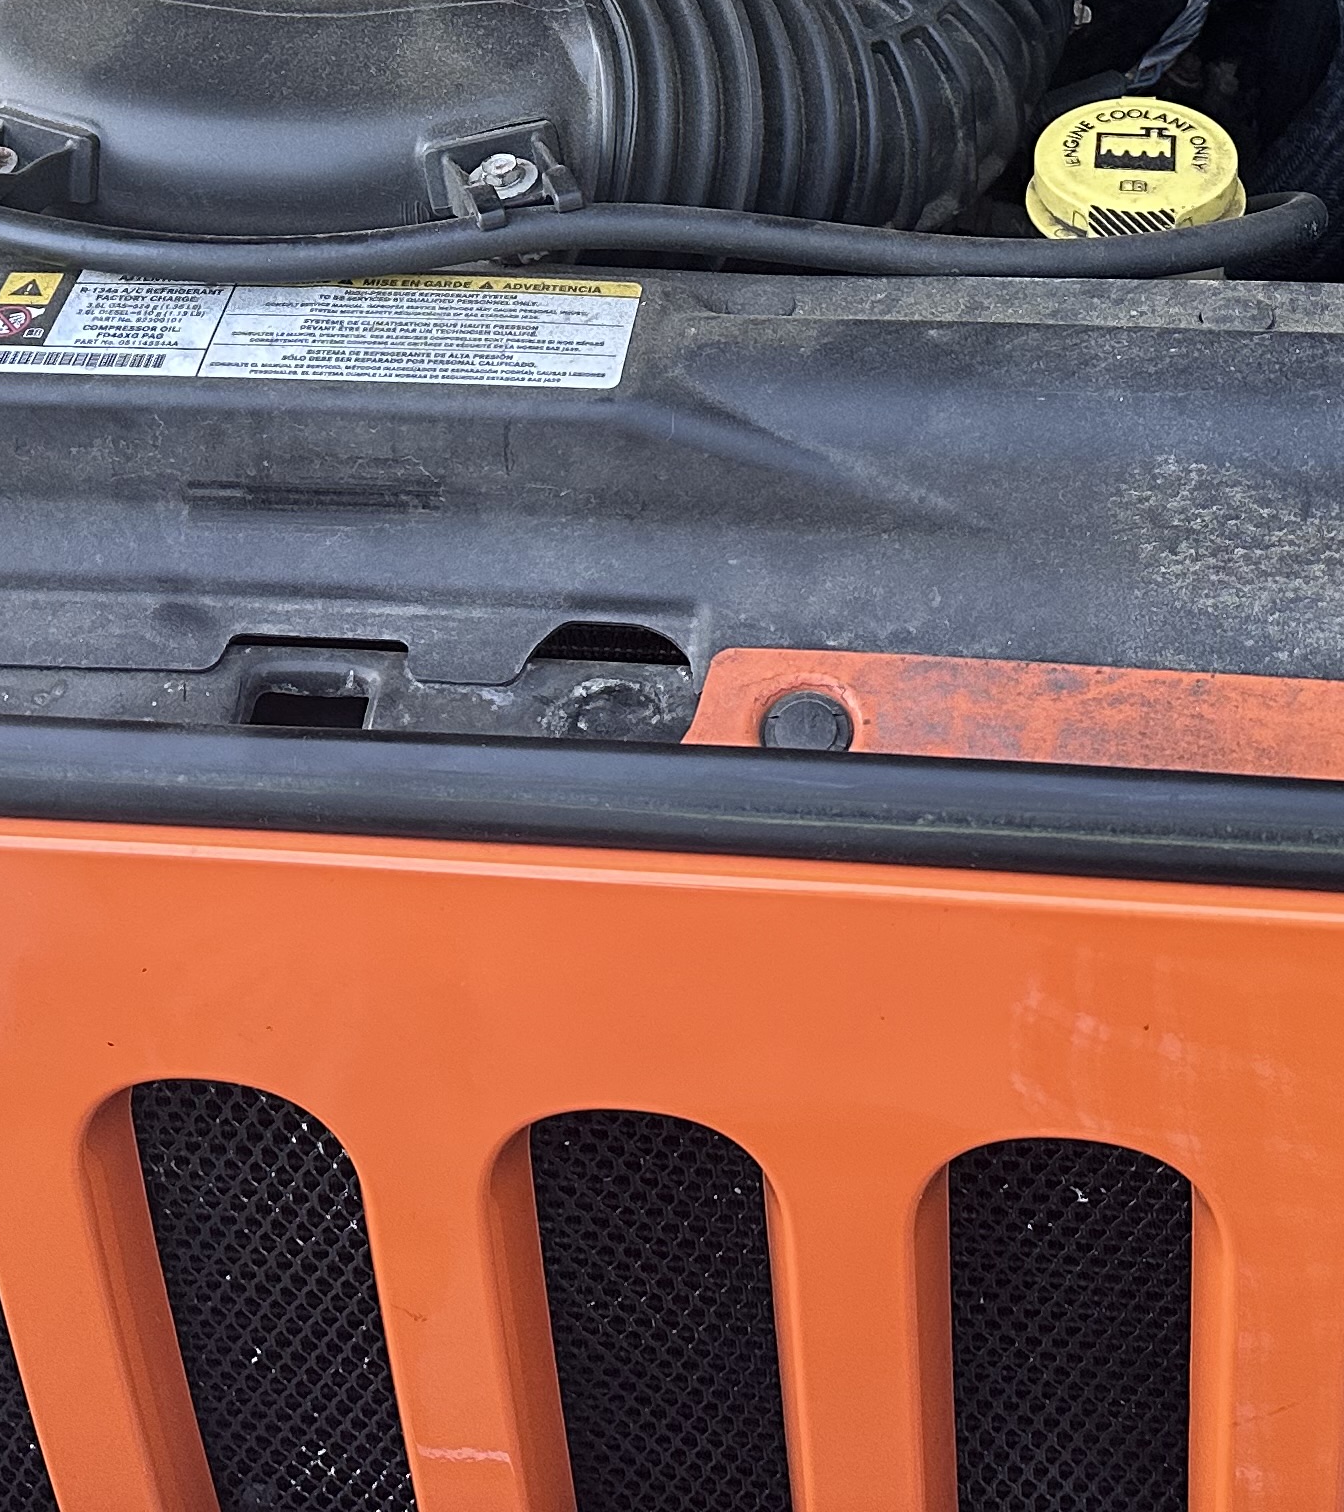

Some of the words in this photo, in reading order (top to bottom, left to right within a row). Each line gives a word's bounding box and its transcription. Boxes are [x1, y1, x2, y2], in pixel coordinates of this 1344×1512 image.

[1063, 120, 1094, 167] ENGINE
[1096, 109, 1197, 133] COOLANT
[1190, 136, 1210, 173] ONLY
[362, 279, 399, 287] MISE
[424, 280, 473, 288] GARDE
[502, 282, 602, 293] ADVERTENCIA
